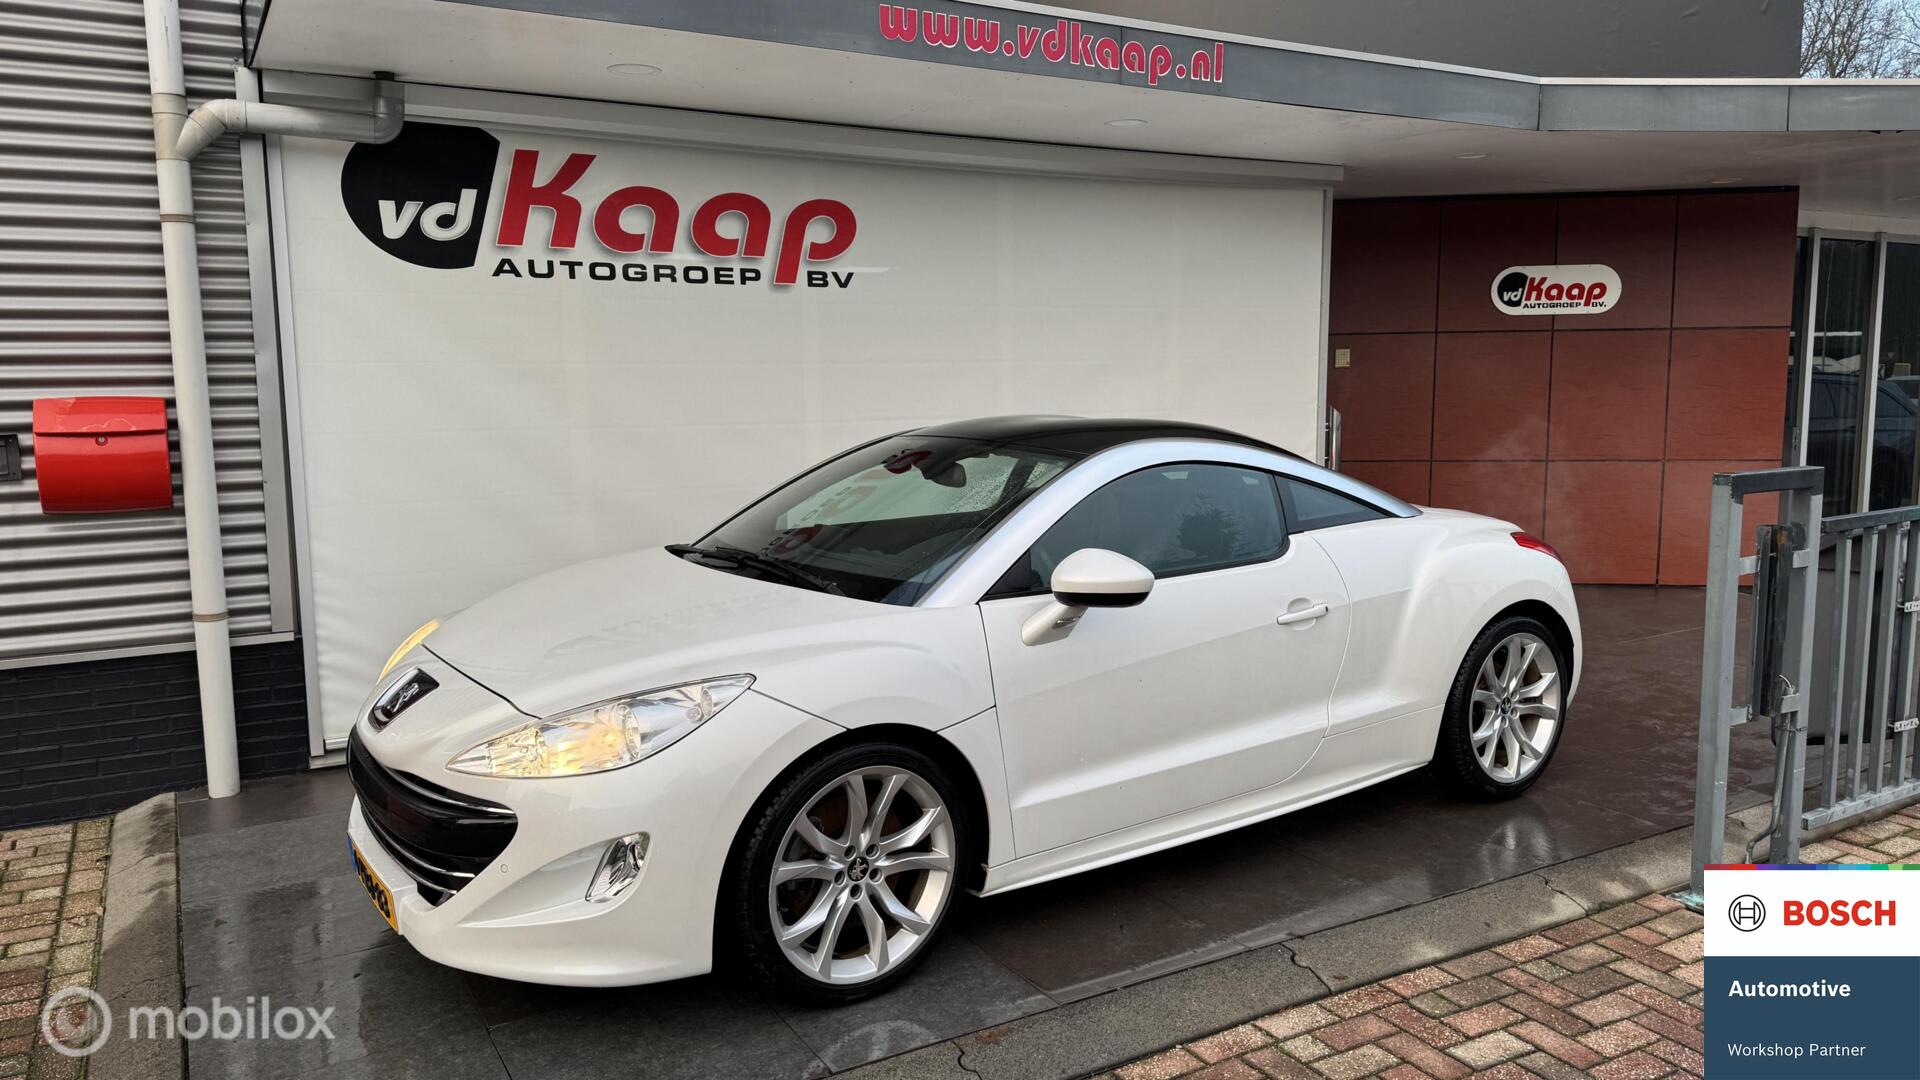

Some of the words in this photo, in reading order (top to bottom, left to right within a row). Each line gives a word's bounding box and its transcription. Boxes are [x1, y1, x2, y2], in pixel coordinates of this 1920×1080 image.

[879, 3, 1225, 86] www.vdkaap.nl
[378, 188, 478, 241] vd
[495, 148, 858, 286] Kaap
[491, 258, 762, 286] AUTOGROEP
[806, 270, 855, 289] BV
[1502, 288, 1523, 302] vd
[1524, 276, 1608, 307] Kaap
[1522, 301, 1582, 309] AUTOGROEP
